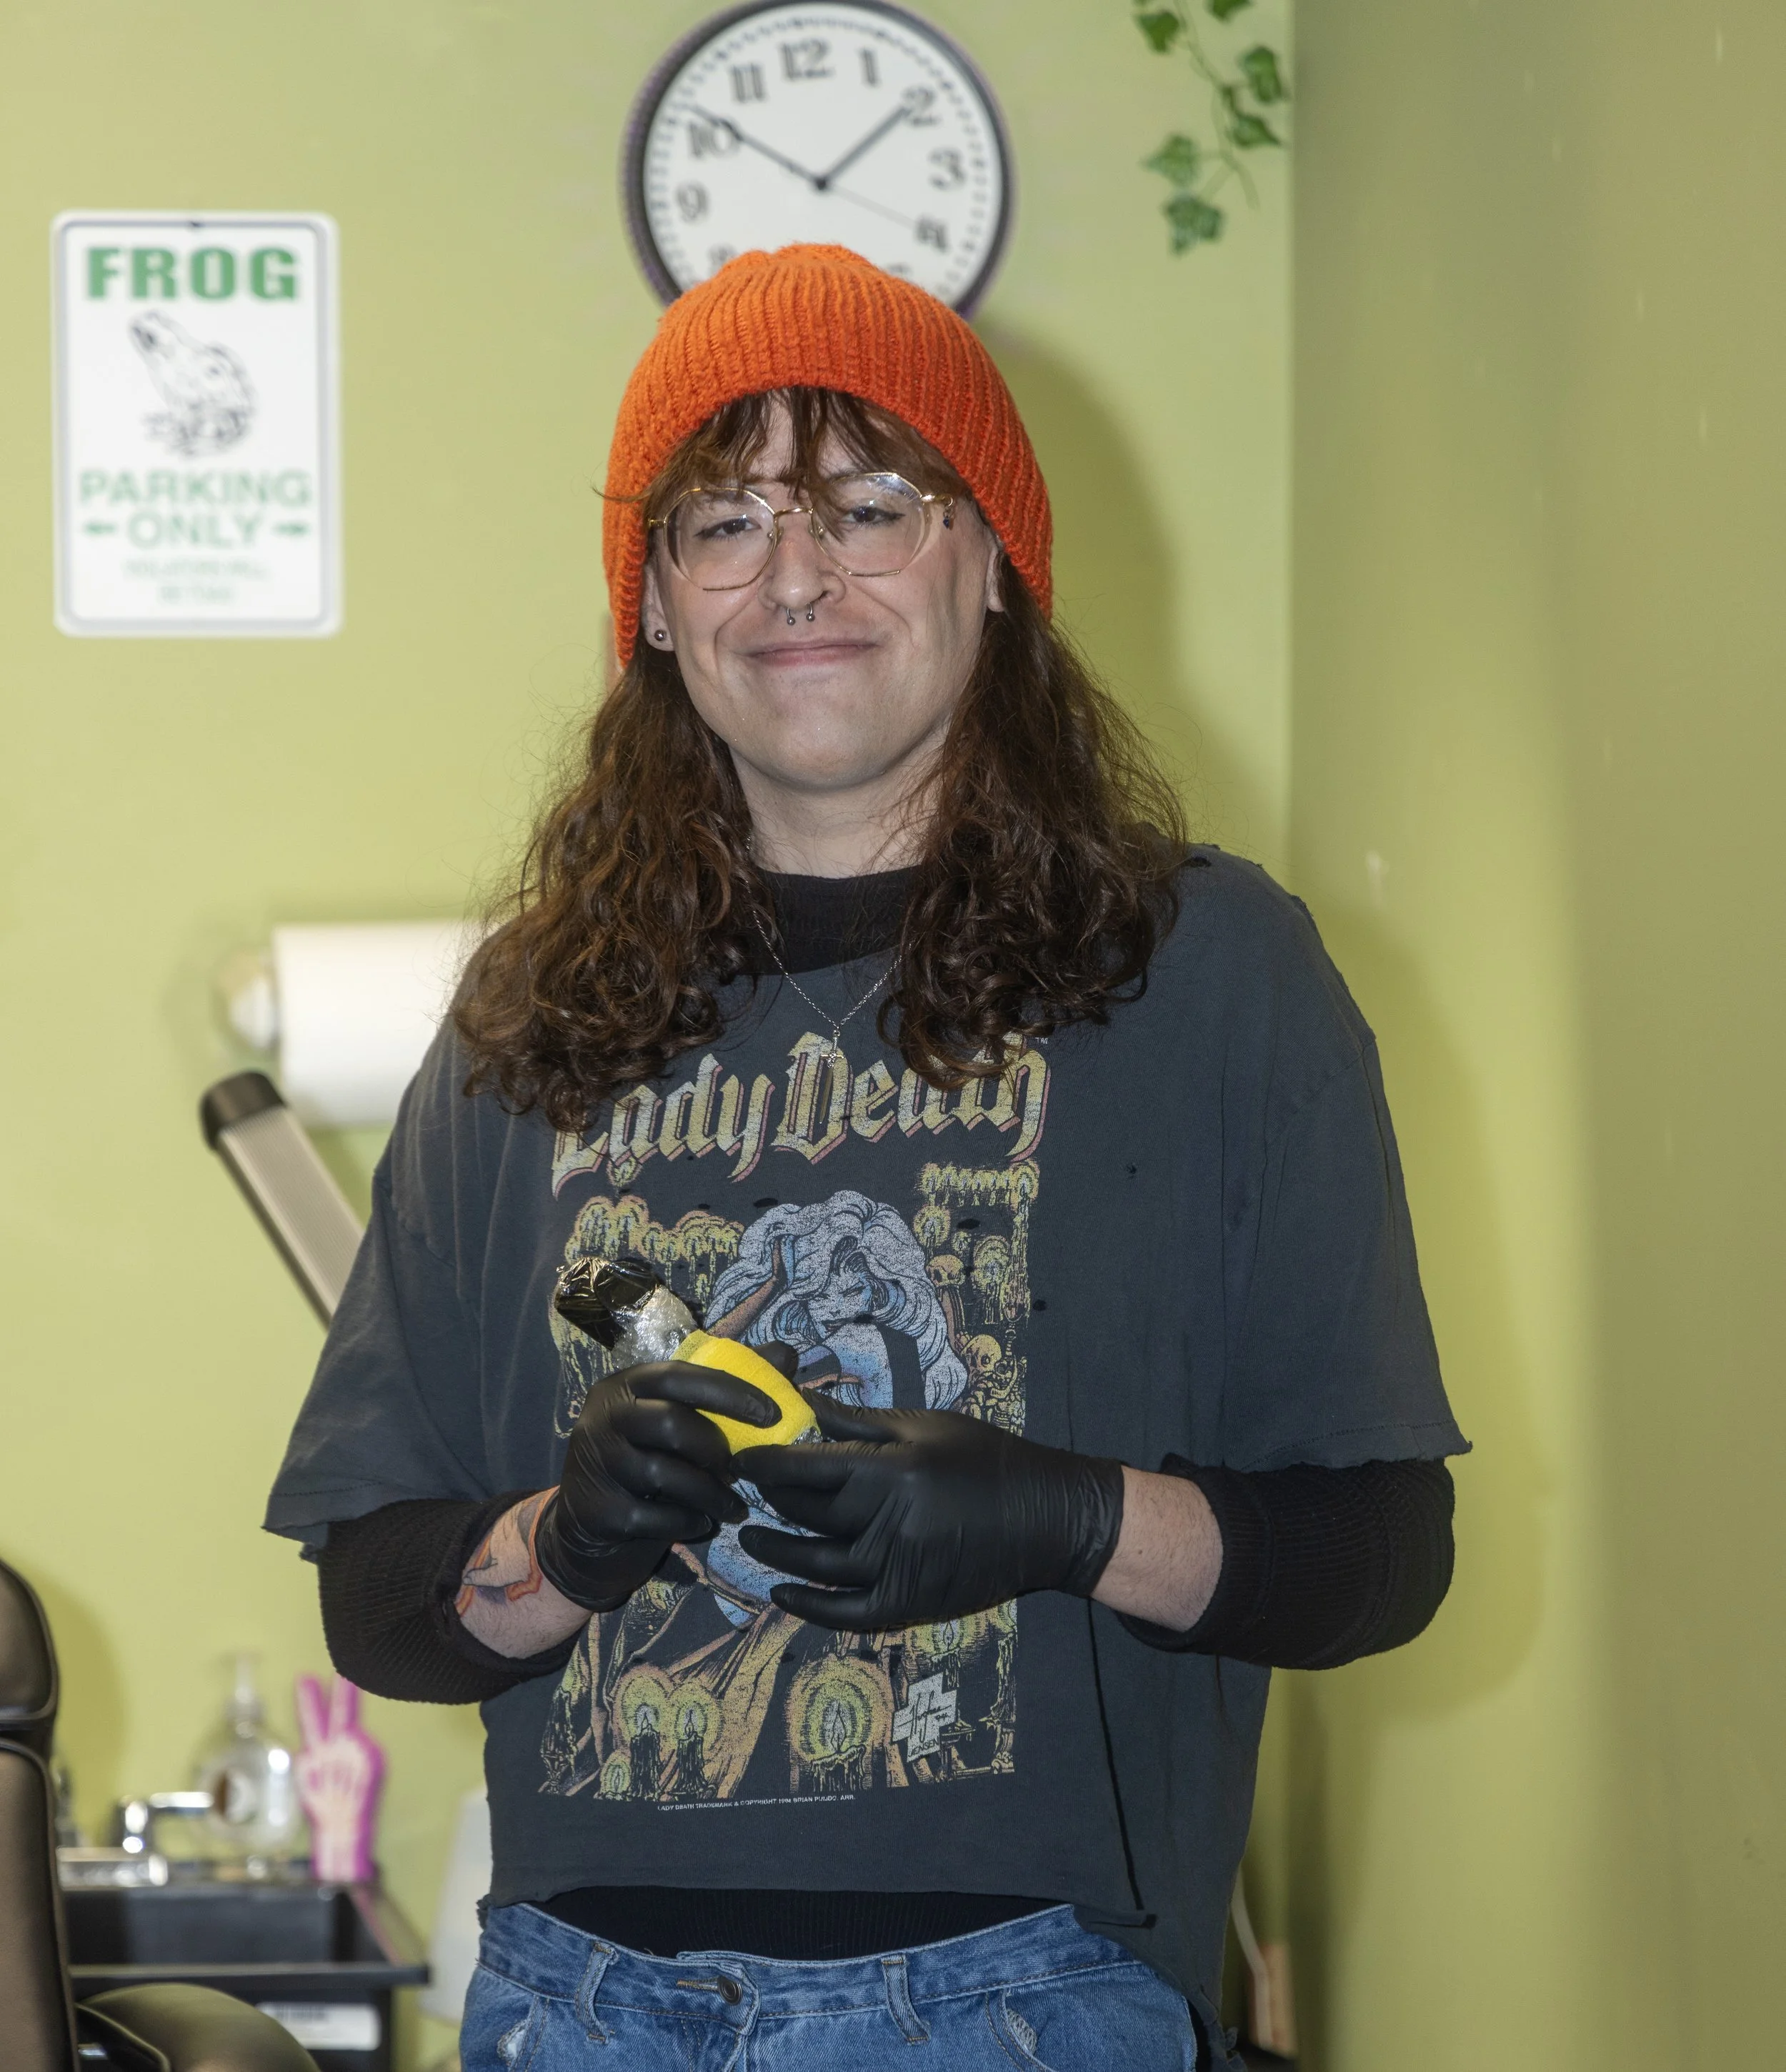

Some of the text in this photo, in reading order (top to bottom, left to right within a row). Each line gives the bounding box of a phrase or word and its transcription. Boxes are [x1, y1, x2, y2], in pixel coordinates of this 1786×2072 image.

[779, 39, 832, 81] 12
[858, 49, 879, 87] 1
[730, 64, 767, 102] 11
[904, 87, 940, 127] 2
[689, 118, 739, 158] 10
[929, 148, 966, 190] 3
[675, 184, 708, 223] 9
[914, 216, 949, 252] 4
[86, 246, 298, 302] FROG
[79, 469, 312, 507] PARKING
[126, 509, 262, 549] ONLY
